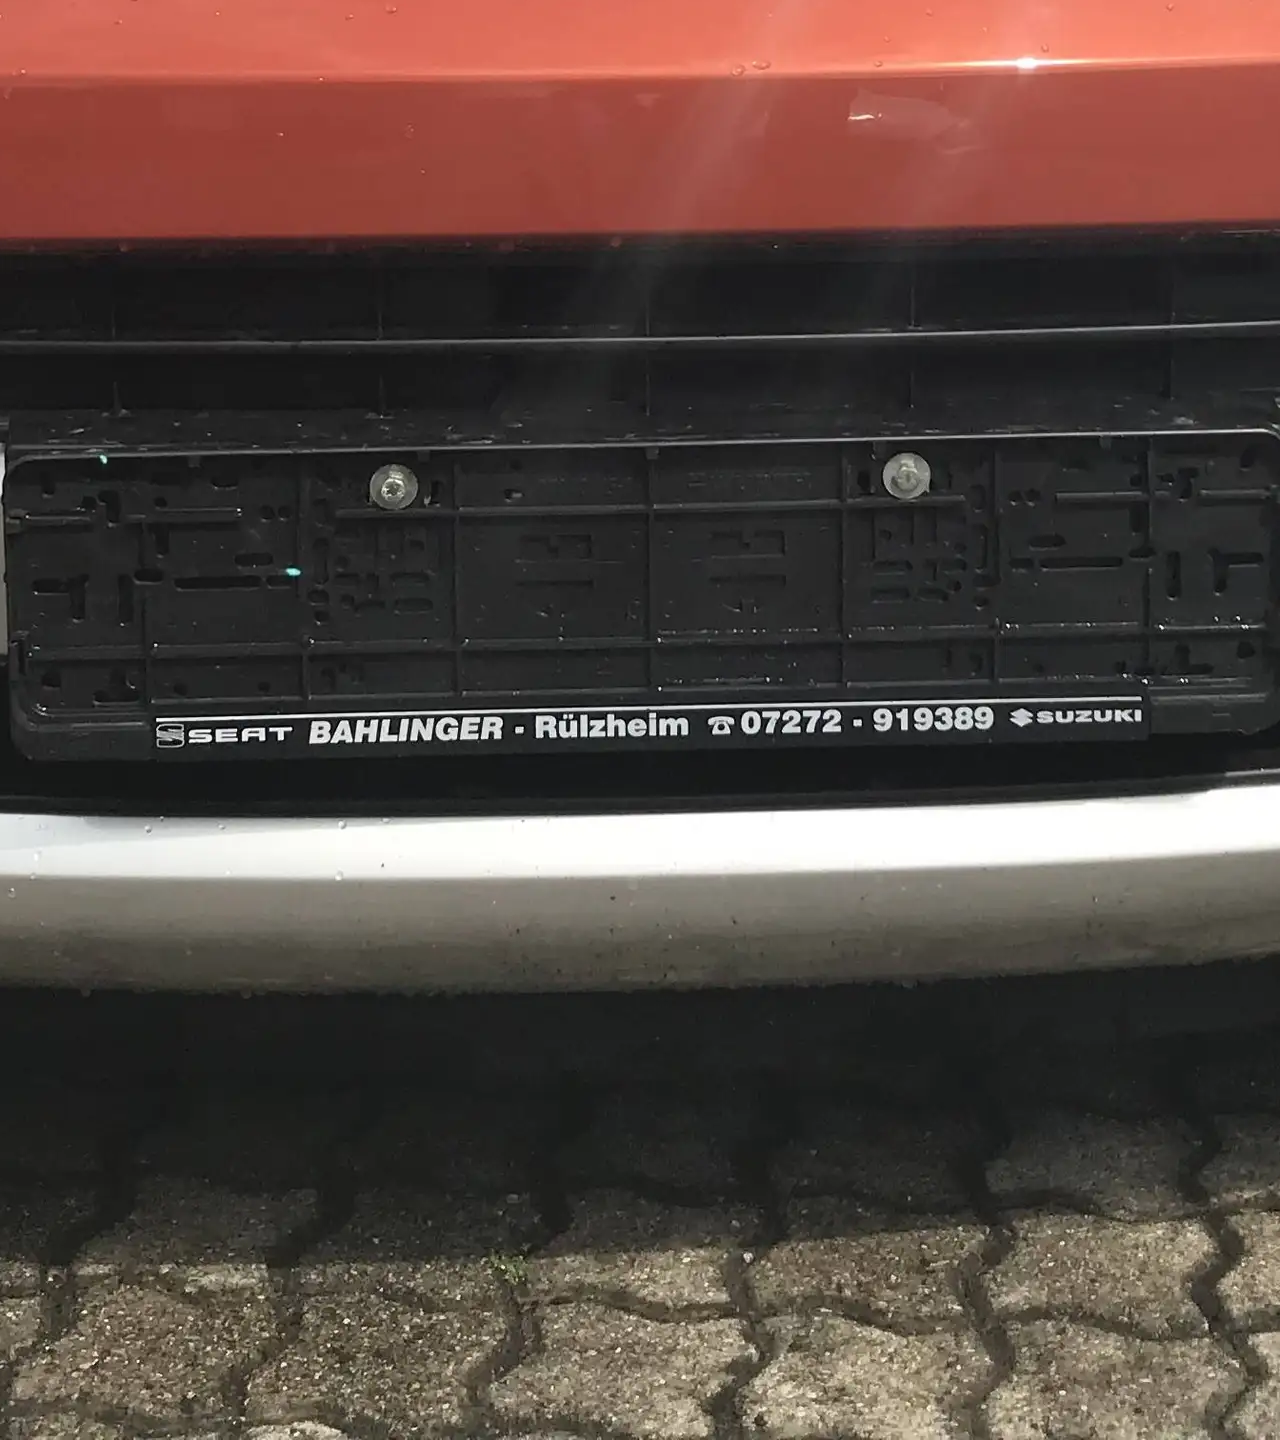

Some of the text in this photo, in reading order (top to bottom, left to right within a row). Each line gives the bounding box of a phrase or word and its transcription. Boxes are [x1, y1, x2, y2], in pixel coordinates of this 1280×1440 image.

[188, 725, 293, 745] SEAT
[308, 716, 504, 745] BAHLINGER
[535, 712, 689, 739] Rülzheim
[740, 708, 842, 735] 07272
[872, 706, 994, 732] 919389
[1036, 708, 1142, 724] SUZUKI
